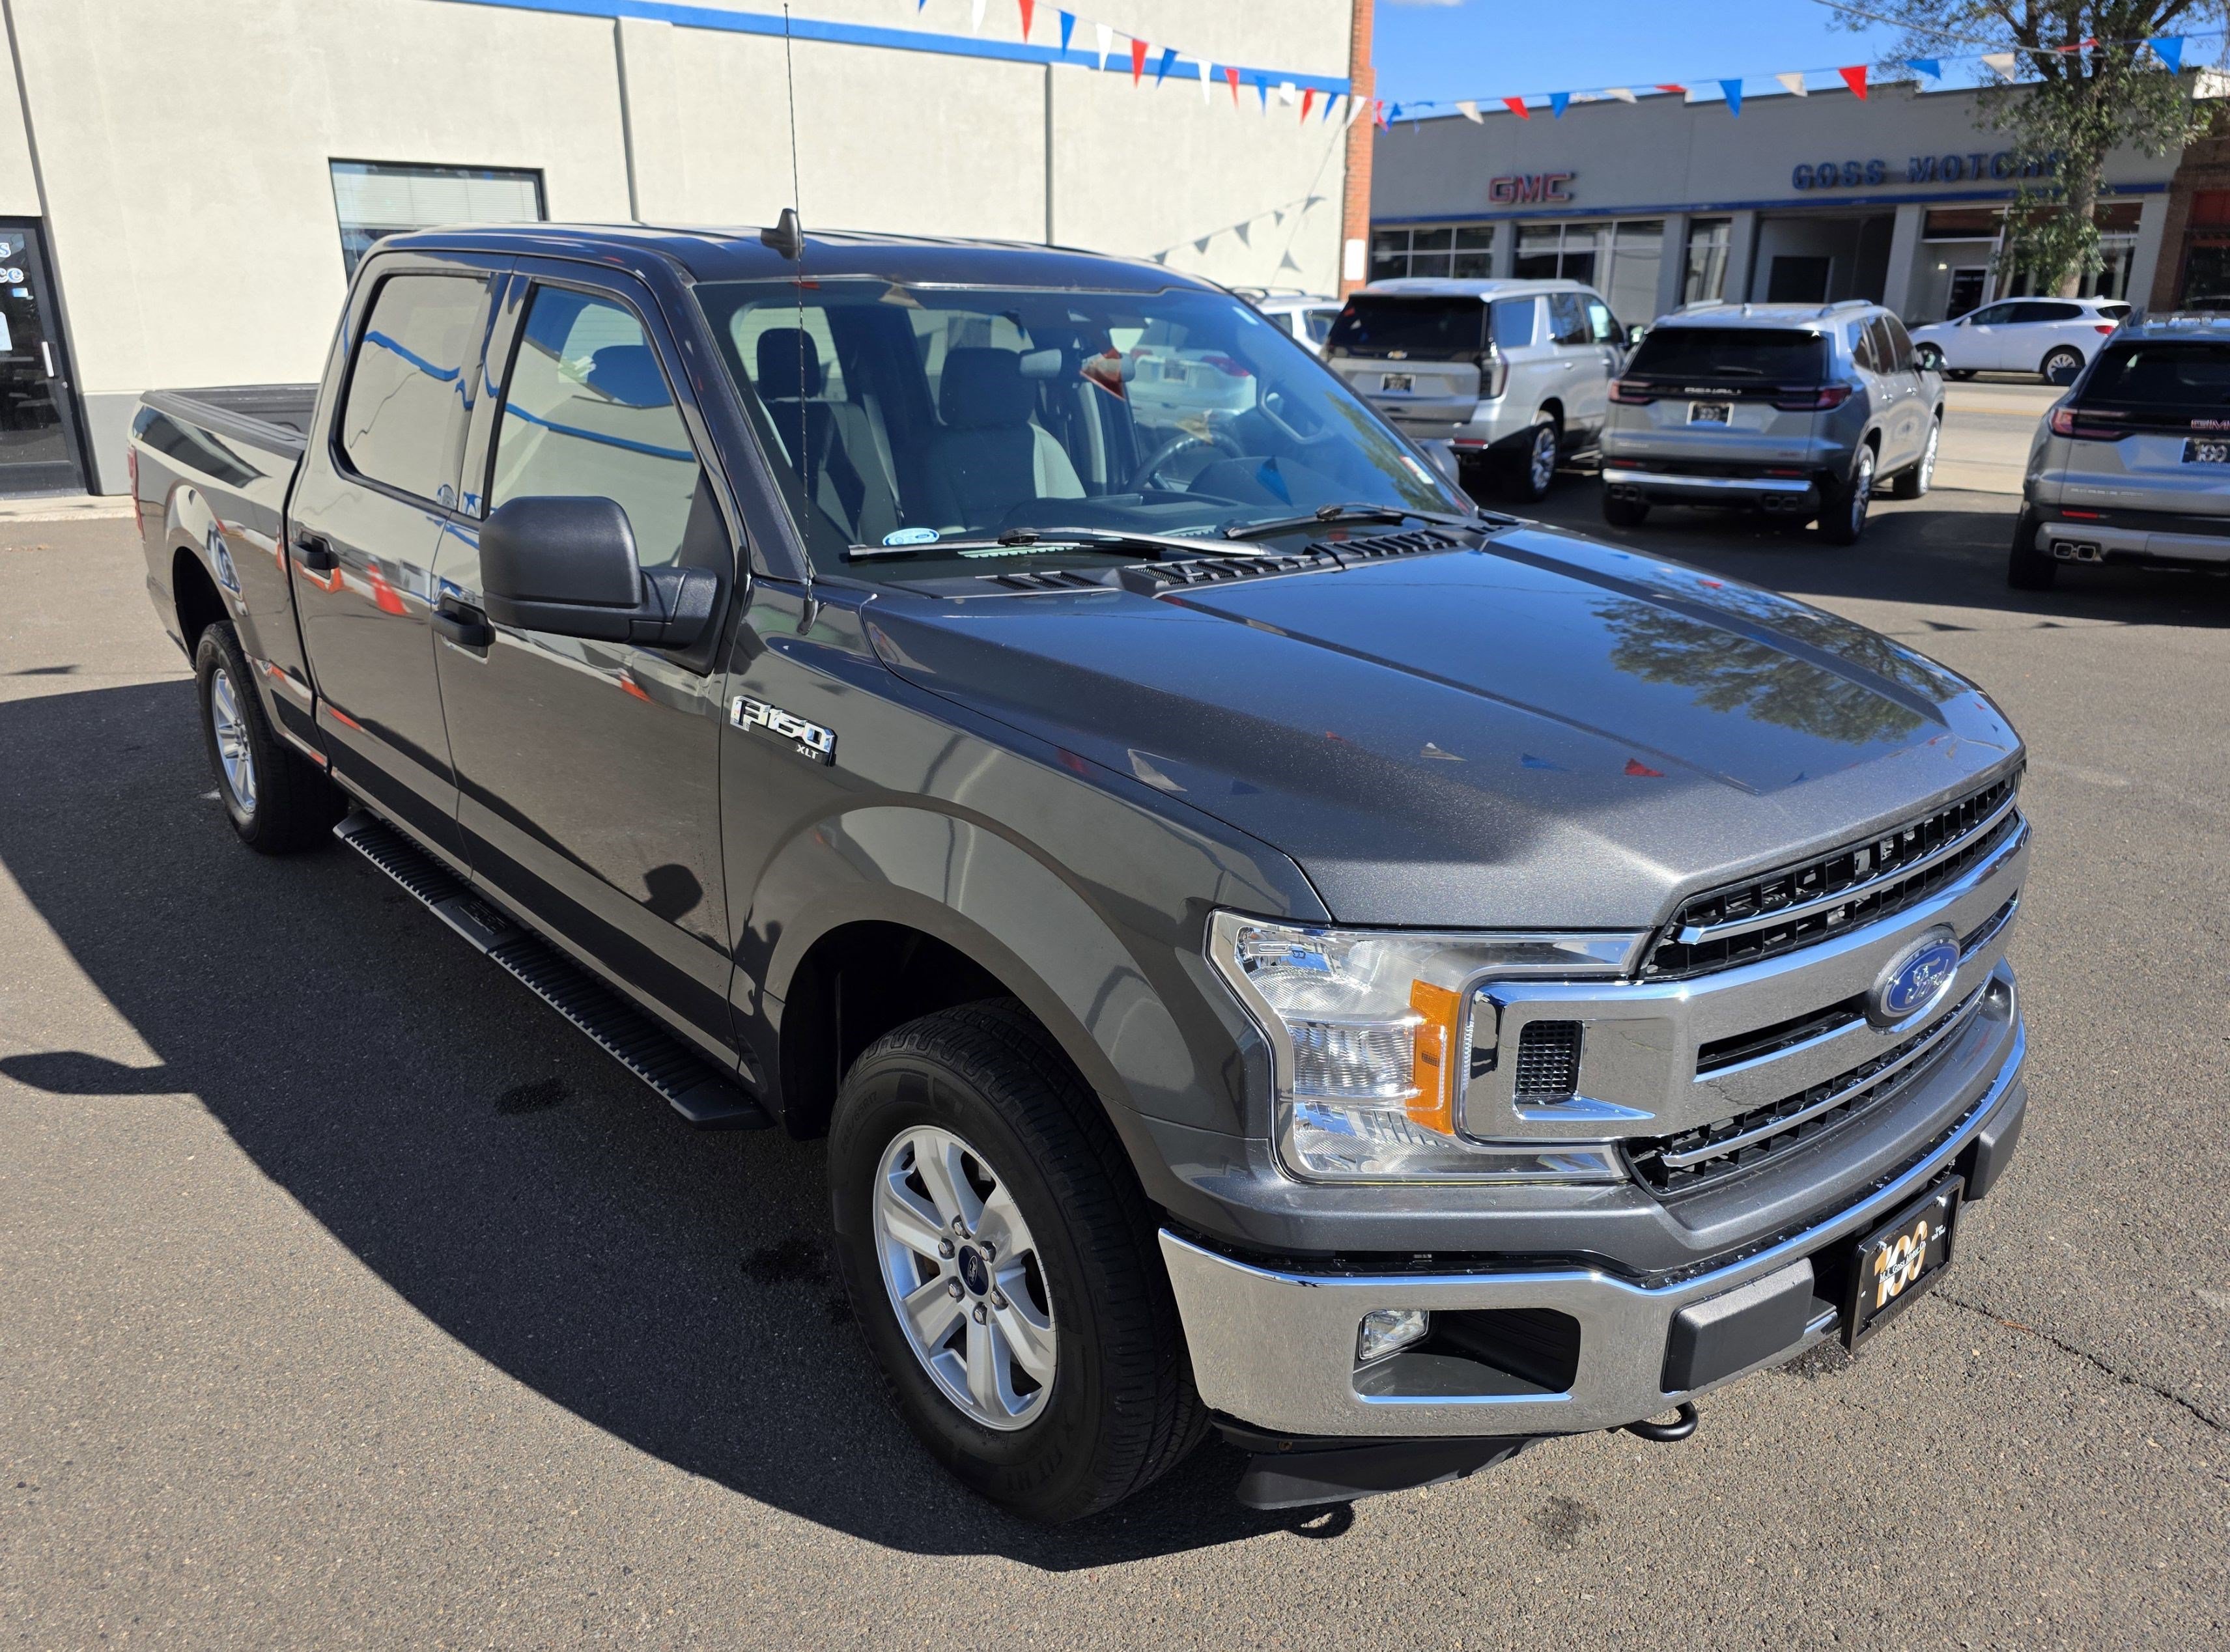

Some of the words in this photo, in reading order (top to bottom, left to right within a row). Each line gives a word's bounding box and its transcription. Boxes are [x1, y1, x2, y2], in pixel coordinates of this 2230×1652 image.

[1489, 173, 1576, 204] GMC
[1792, 159, 1885, 190] GOSS
[796, 744, 819, 759] XLT
[1904, 956, 1949, 1005] Ford
[1874, 1220, 1928, 1309] 100
[1892, 1259, 1905, 1273] Goss
